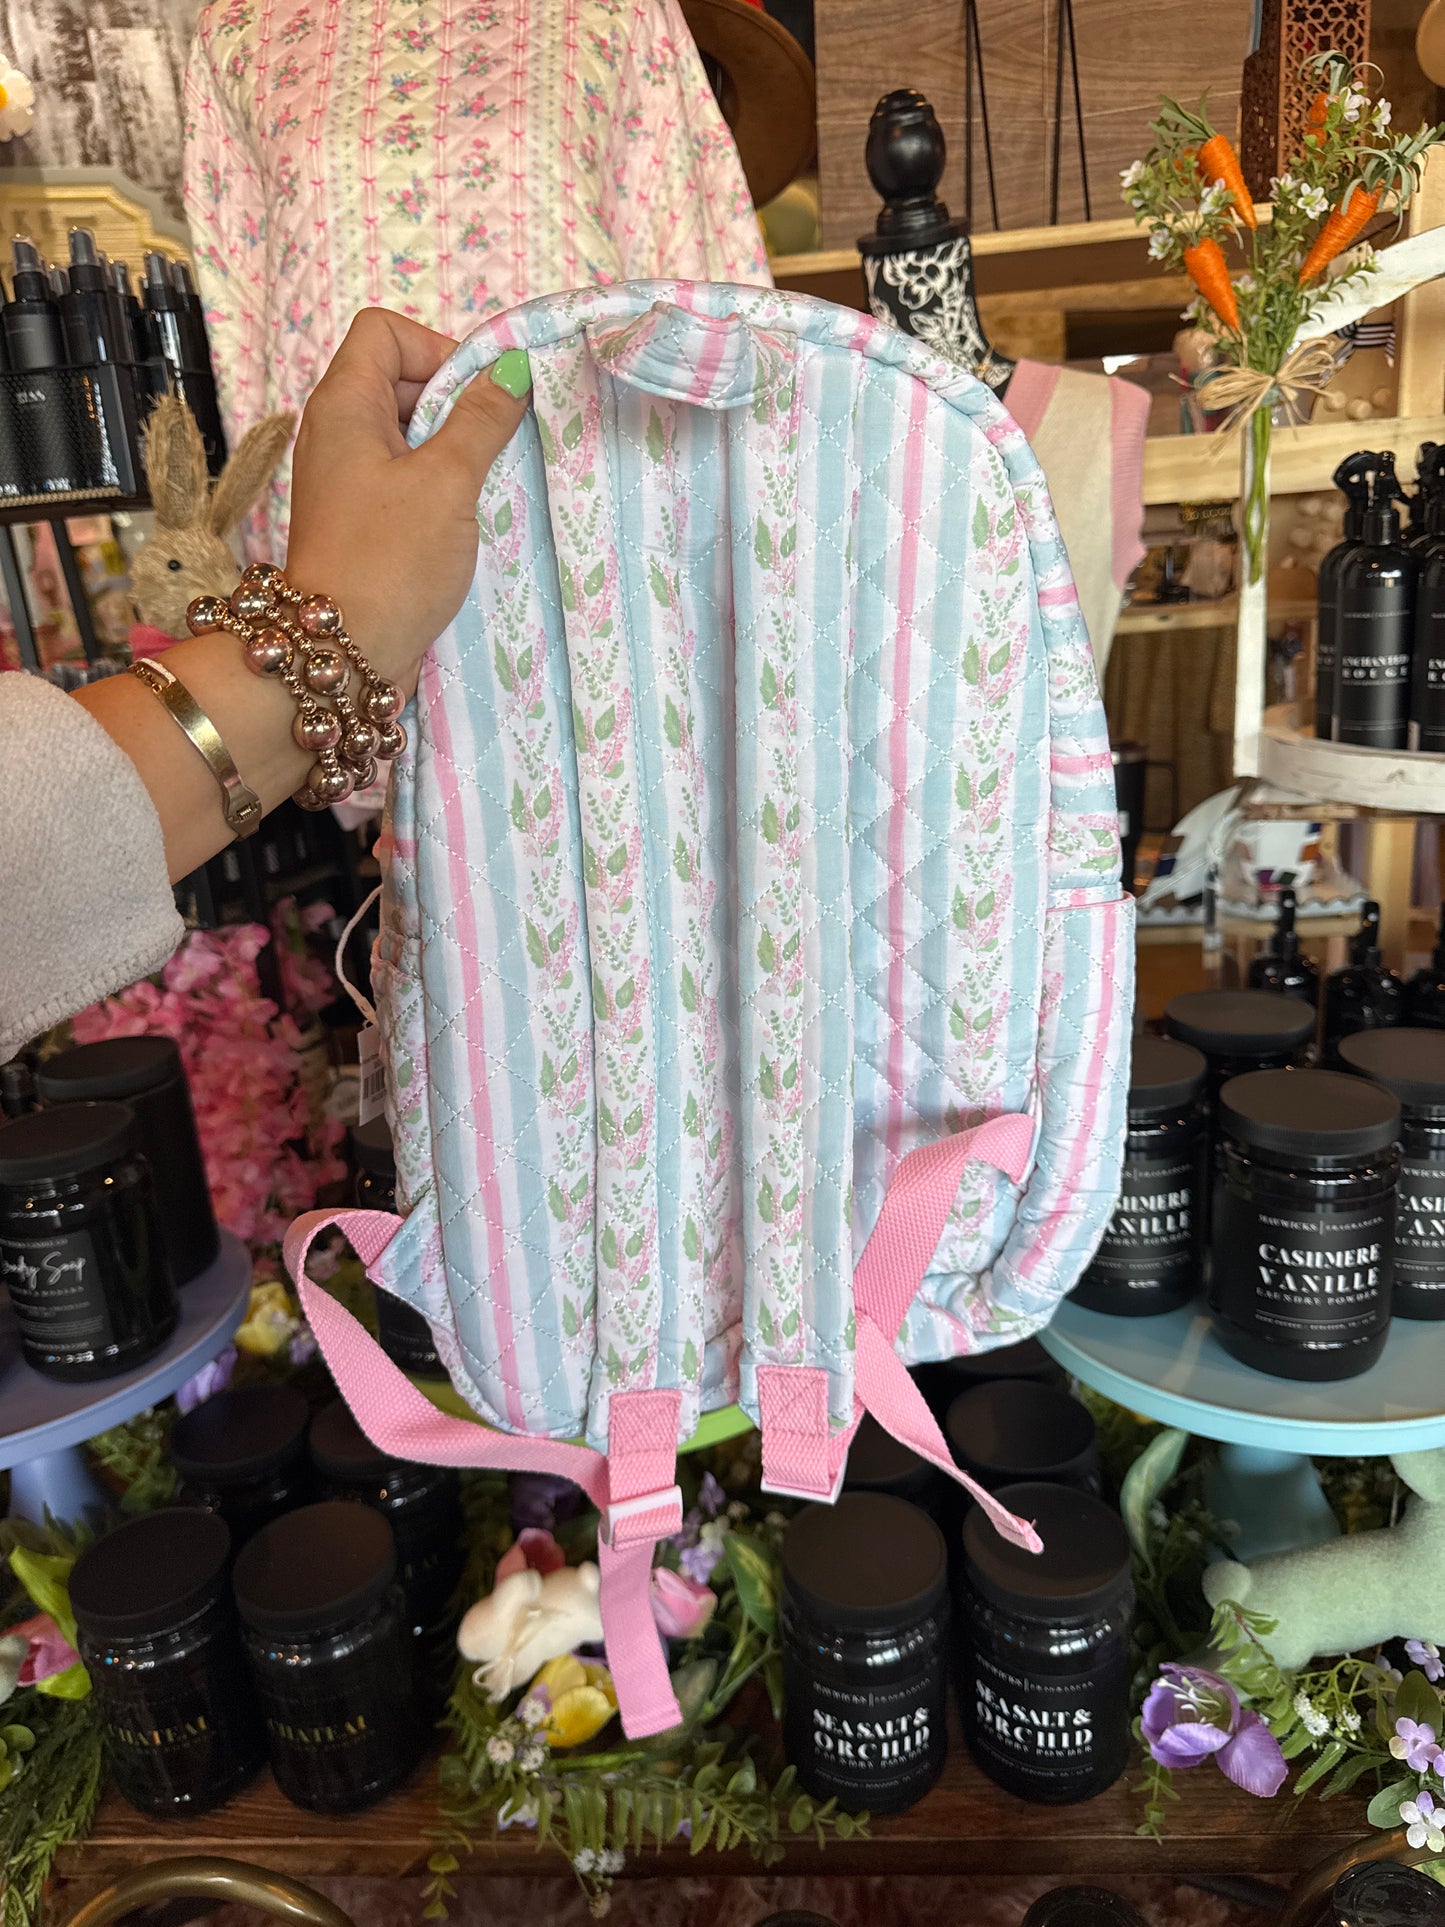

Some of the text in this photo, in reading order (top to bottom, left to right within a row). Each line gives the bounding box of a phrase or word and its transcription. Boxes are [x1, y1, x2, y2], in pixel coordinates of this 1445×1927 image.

[1258, 1243, 1382, 1269] CASHMERE
[1259, 1265, 1380, 1294] VANILLE
[1327, 1289, 1379, 1306] POWDER
[913, 1707, 930, 1728] &
[976, 1701, 1093, 1749] ORCHID
[1072, 1708, 1093, 1727] &
[813, 1725, 931, 1760] ORCHID
